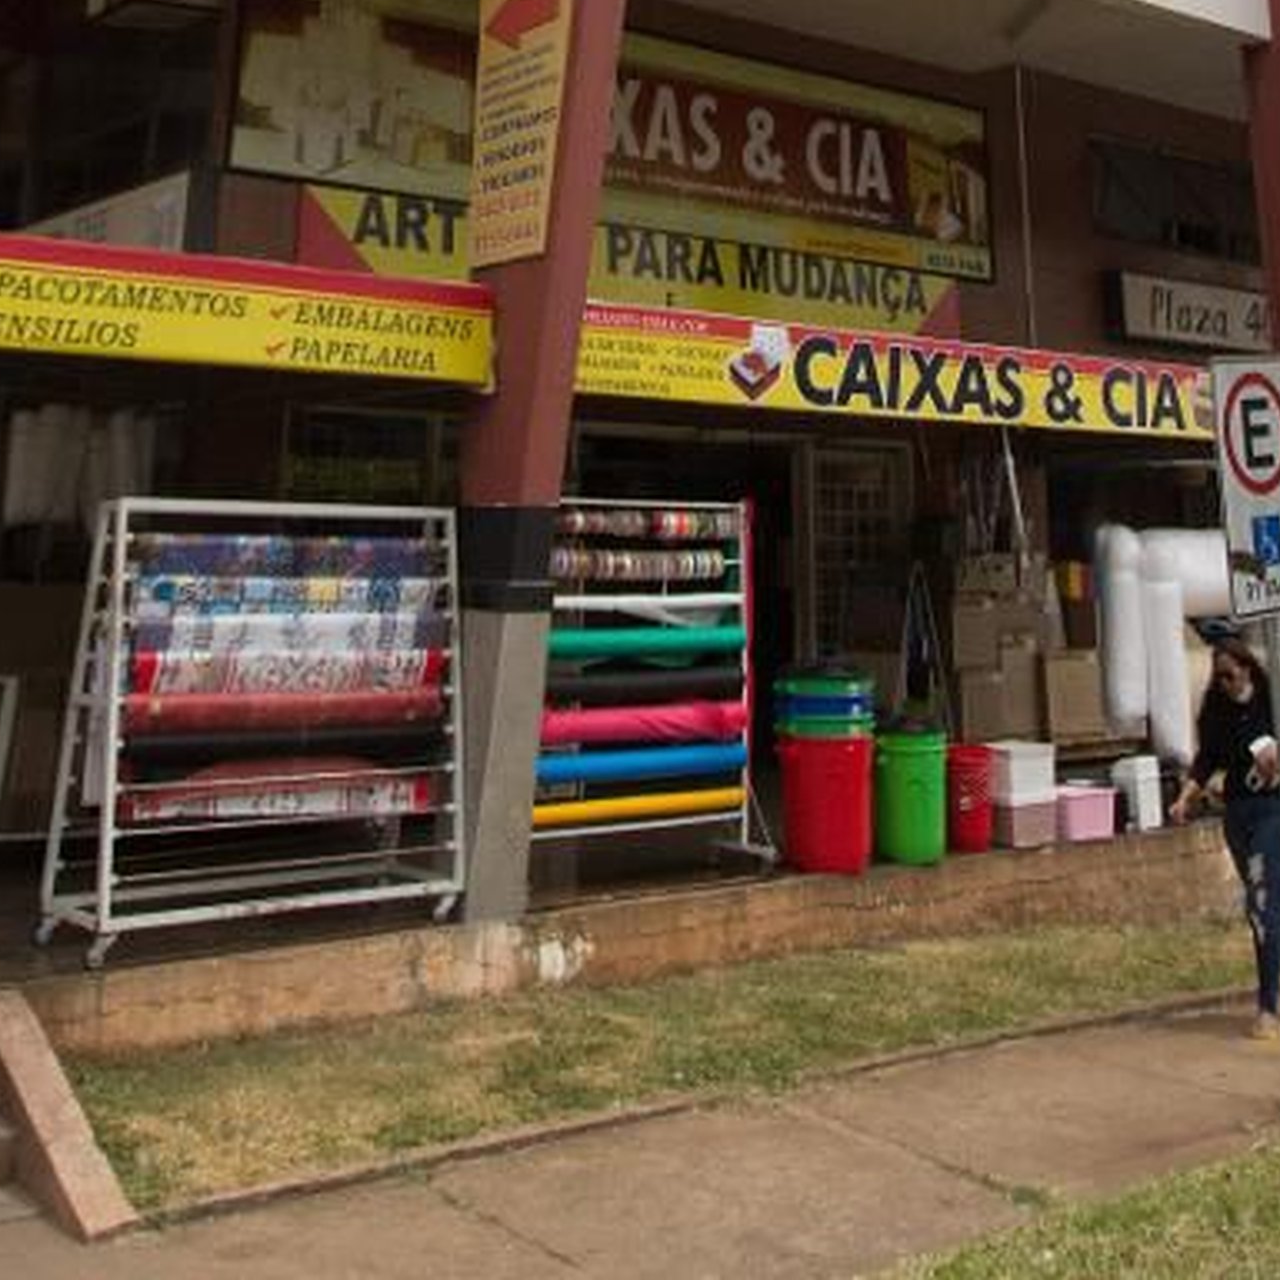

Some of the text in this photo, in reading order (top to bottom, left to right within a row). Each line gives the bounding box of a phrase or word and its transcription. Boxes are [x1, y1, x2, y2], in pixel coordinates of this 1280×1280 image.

[610, 78, 721, 172] XAS
[806, 119, 893, 204] CIA
[607, 222, 726, 287] PARA
[738, 241, 928, 320] MUDANÇA
[292, 302, 474, 341] EMBALAGENS
[1149, 284, 1230, 338] Plaza
[288, 339, 437, 373] PAPELARIA
[791, 334, 1025, 420] CAIXAS
[1043, 364, 1085, 424] &
[1101, 364, 1187, 430] CIA
[1241, 397, 1275, 469] E
